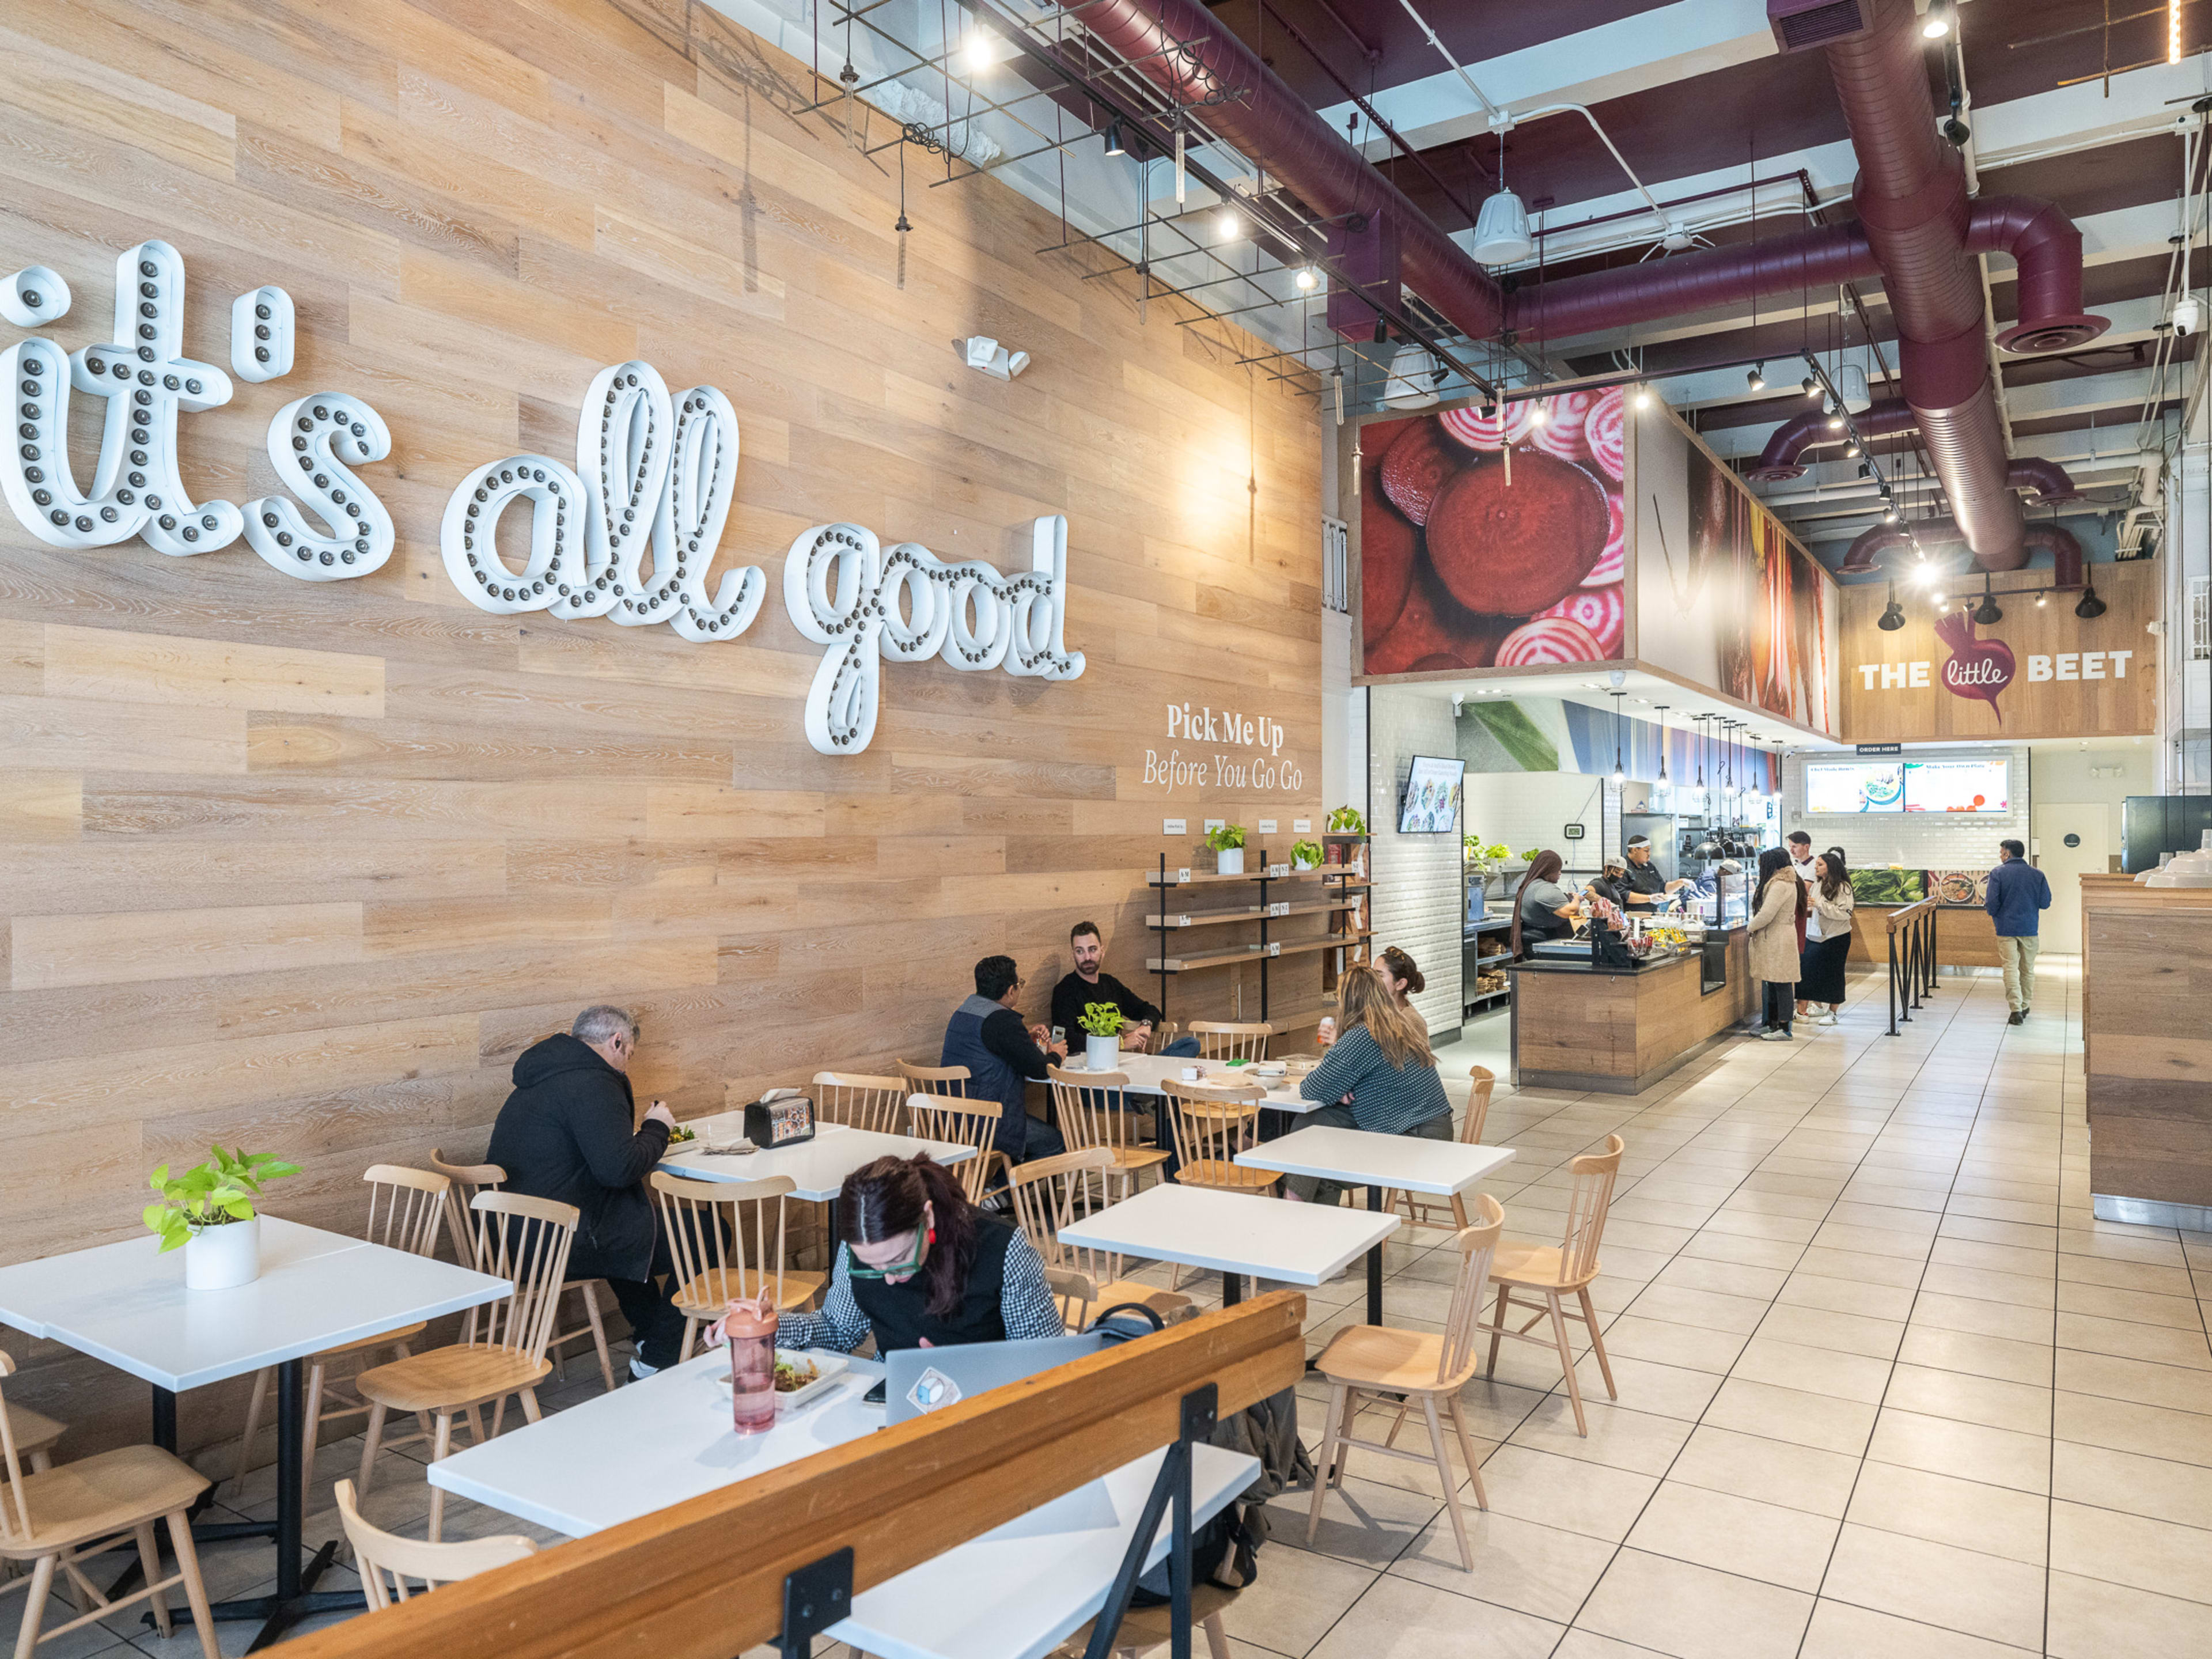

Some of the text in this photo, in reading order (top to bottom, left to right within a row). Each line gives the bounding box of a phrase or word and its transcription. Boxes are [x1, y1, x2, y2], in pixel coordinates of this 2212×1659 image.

[0, 239, 1086, 756] it's all good
[1858, 650, 2133, 690] THE little BEET
[1166, 702, 1284, 756] Pick Me Up
[1142, 749, 1302, 795] Before You Go Go
